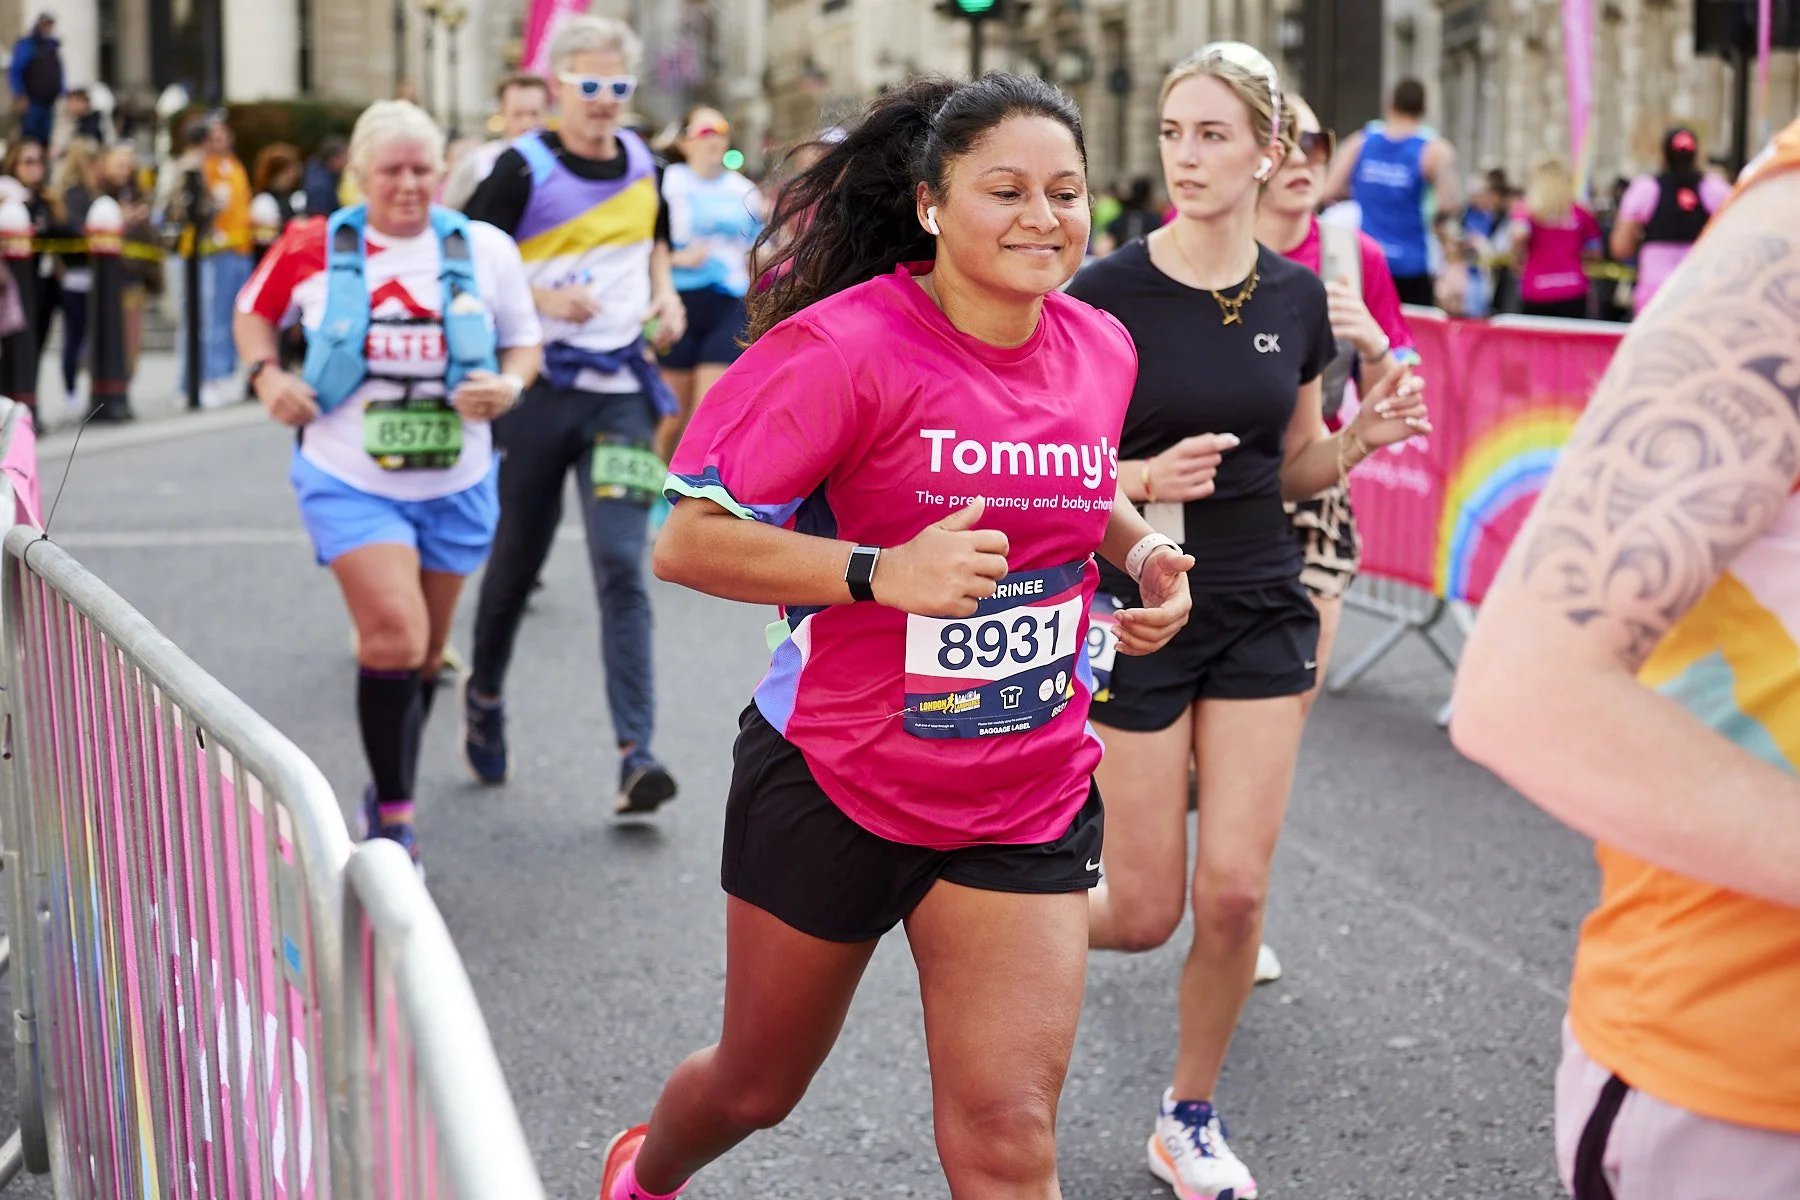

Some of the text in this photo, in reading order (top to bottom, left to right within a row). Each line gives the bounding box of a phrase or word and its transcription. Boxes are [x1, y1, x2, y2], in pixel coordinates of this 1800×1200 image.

[1253, 332, 1281, 353] CK
[378, 420, 452, 447] 8573
[919, 429, 1118, 489] Tommy's
[915, 490, 945, 505] The
[949, 495, 1030, 511] prenancy
[1033, 494, 1059, 509] and
[1061, 494, 1091, 513] baby
[978, 579, 1044, 601] RINEE
[937, 610, 1060, 671] 8931
[919, 699, 948, 712] LONDON
[979, 722, 1031, 736] BAGGAGE LABEL
